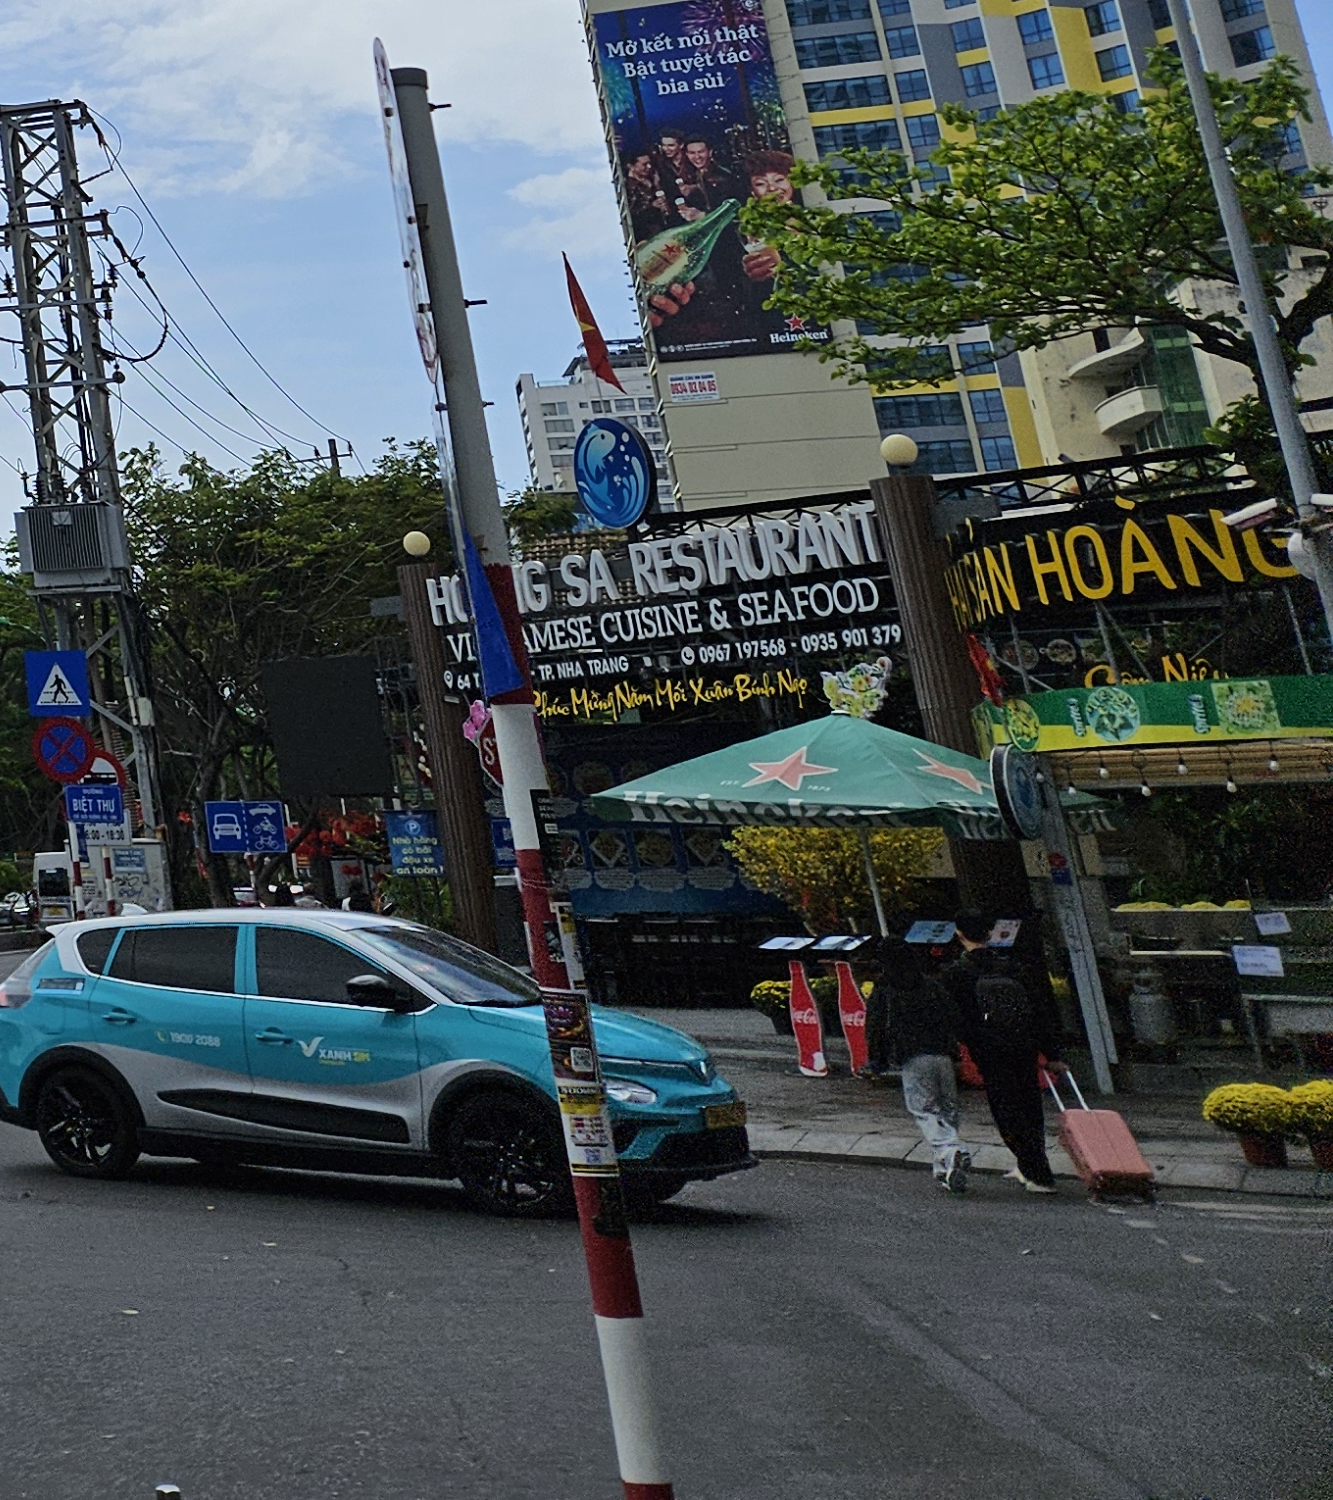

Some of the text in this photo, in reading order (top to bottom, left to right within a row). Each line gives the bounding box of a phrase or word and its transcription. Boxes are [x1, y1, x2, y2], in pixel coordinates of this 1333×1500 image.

[605, 24, 760, 58] Mở kết nối thật
[622, 46, 752, 80] Bật tuyệt tác
[657, 72, 725, 97] bia sủi
[769, 330, 829, 344] Heineken
[560, 548, 620, 608] SA
[628, 500, 881, 597] RESTAURANT
[600, 600, 703, 644] CUISINE
[709, 598, 732, 631] &
[737, 577, 879, 627] SEAFOOD
[698, 643, 731, 664] 0967
[735, 638, 786, 660] 197568
[800, 633, 838, 654] 0935
[842, 628, 868, 648] 901
[872, 624, 901, 645] 379
[457, 675, 472, 690] 64
[539, 663, 556, 681] TP.
[557, 660, 583, 678] NHA
[587, 655, 629, 676] TRANG
[689, 675, 733, 706] Xuân
[734, 672, 776, 702] Bính
[777, 668, 808, 709] Ngọ
[72, 796, 93, 814] BIỆT
[413, 835, 438, 846] hàng
[396, 867, 410, 875] an
[412, 865, 437, 875] toàn
[195, 1035, 221, 1048] 2088
[319, 1048, 352, 1062] XANH
